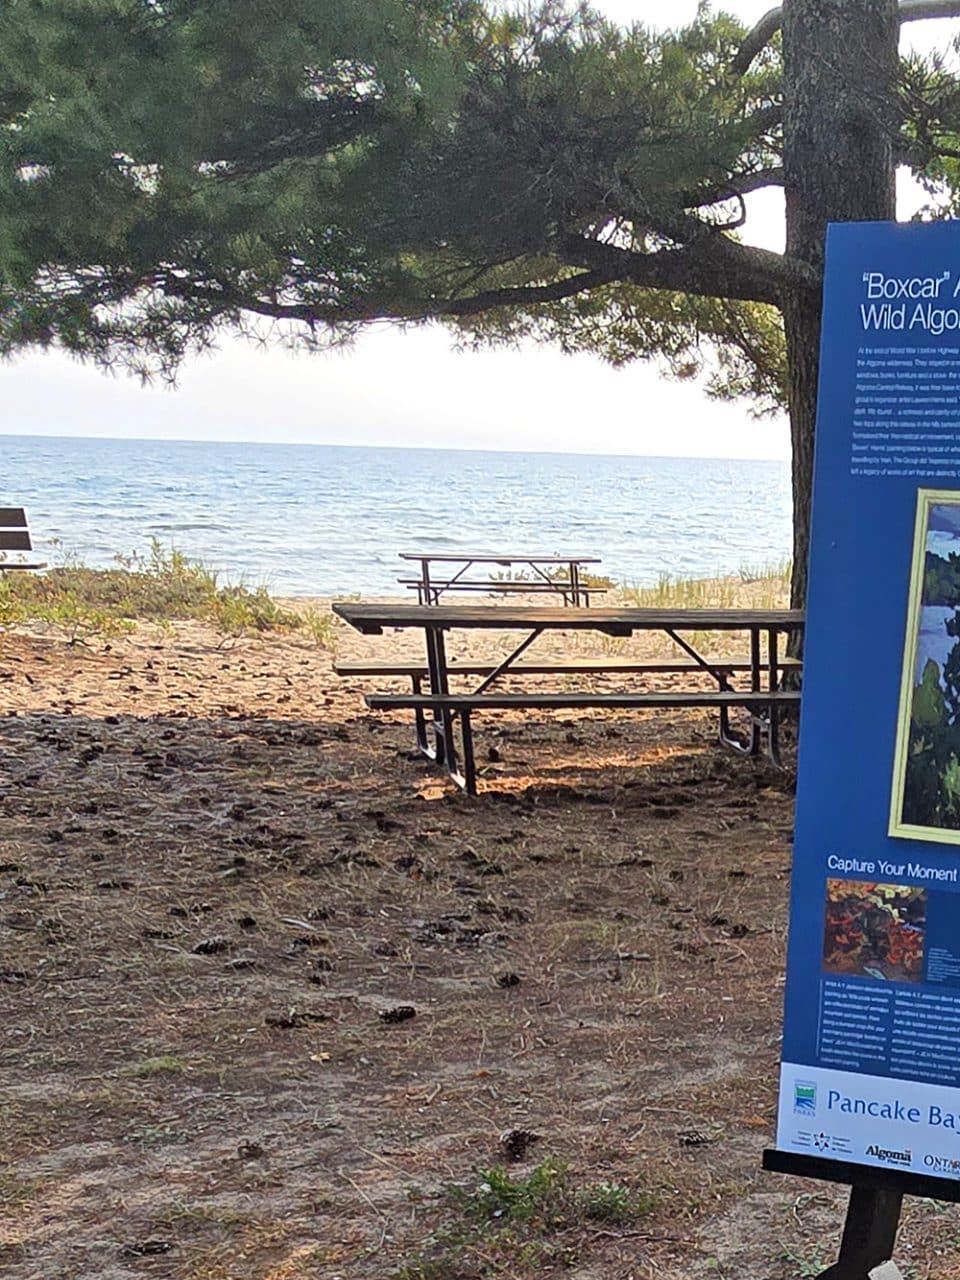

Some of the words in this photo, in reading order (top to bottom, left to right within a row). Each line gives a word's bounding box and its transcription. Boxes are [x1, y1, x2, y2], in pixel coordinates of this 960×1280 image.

[862, 271, 950, 298] “Boxcar”
[860, 303, 905, 330] Wild
[828, 855, 875, 874] Capture
[877, 860, 905, 877] Your
[907, 864, 957, 883] Moment
[827, 1090, 920, 1123] Pancake
